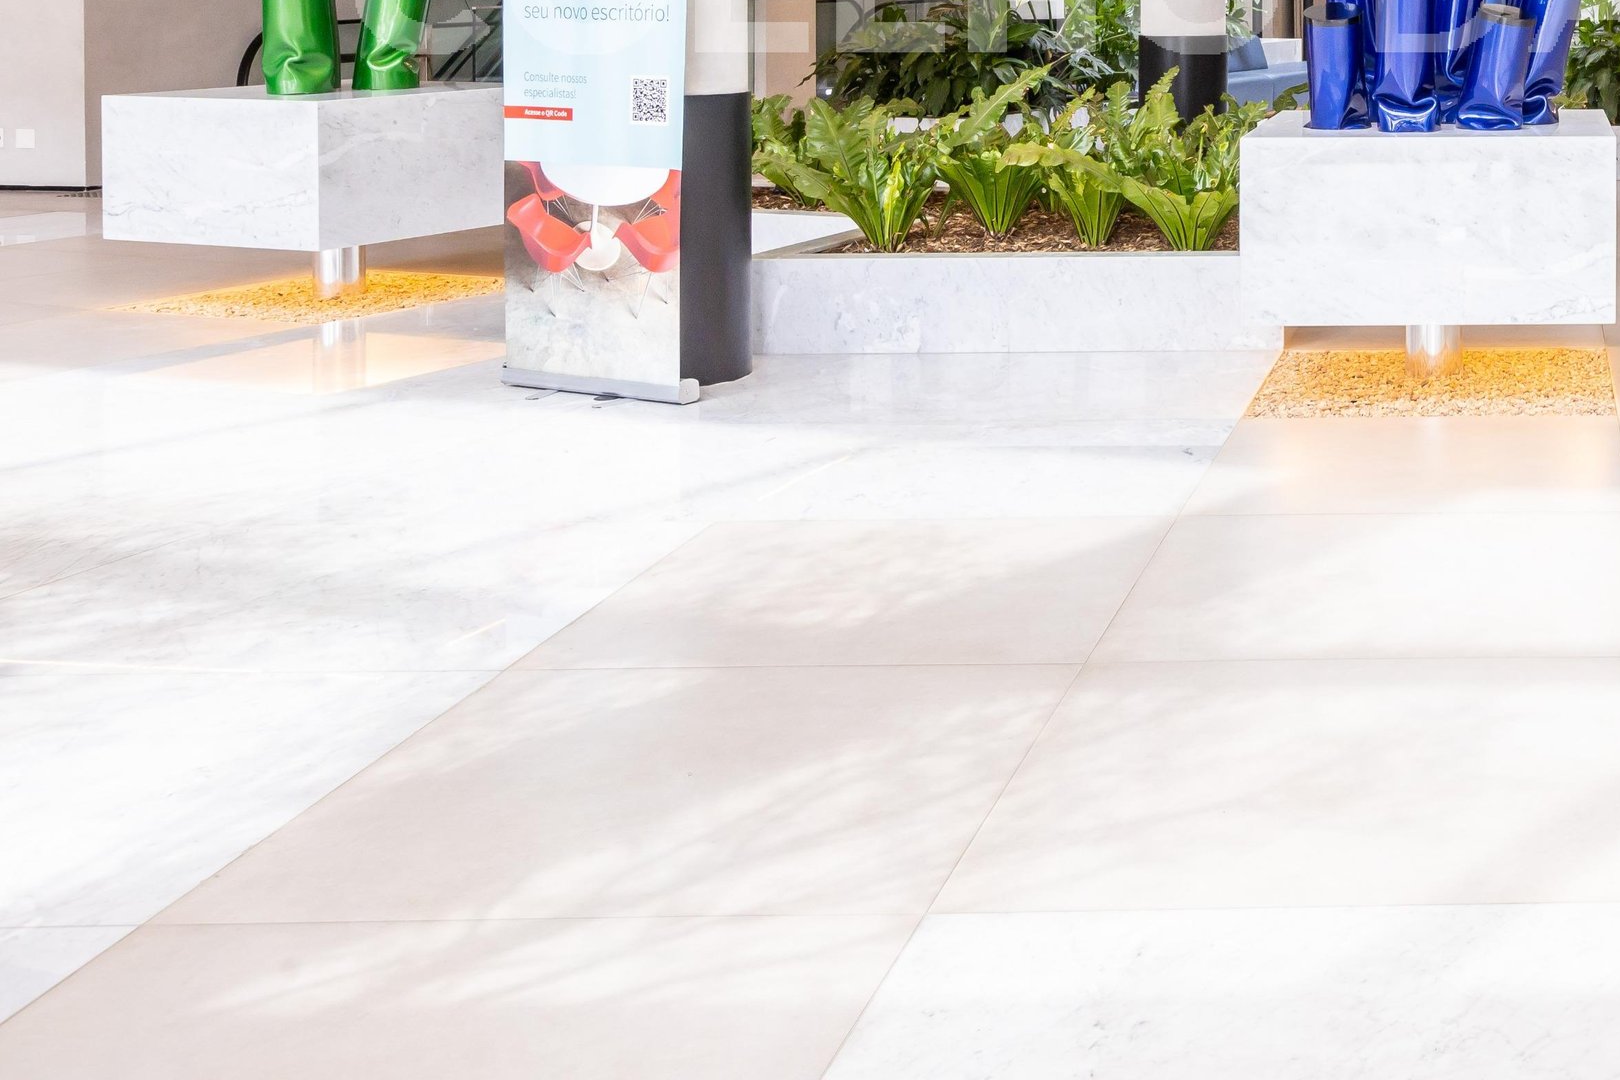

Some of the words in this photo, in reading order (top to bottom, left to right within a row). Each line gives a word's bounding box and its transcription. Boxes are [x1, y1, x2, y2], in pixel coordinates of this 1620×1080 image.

[524, 4, 549, 19] seu
[553, 5, 588, 20] novo
[591, 1, 670, 22] escritório!
[523, 71, 560, 82] Consulte
[561, 74, 588, 84] nossos
